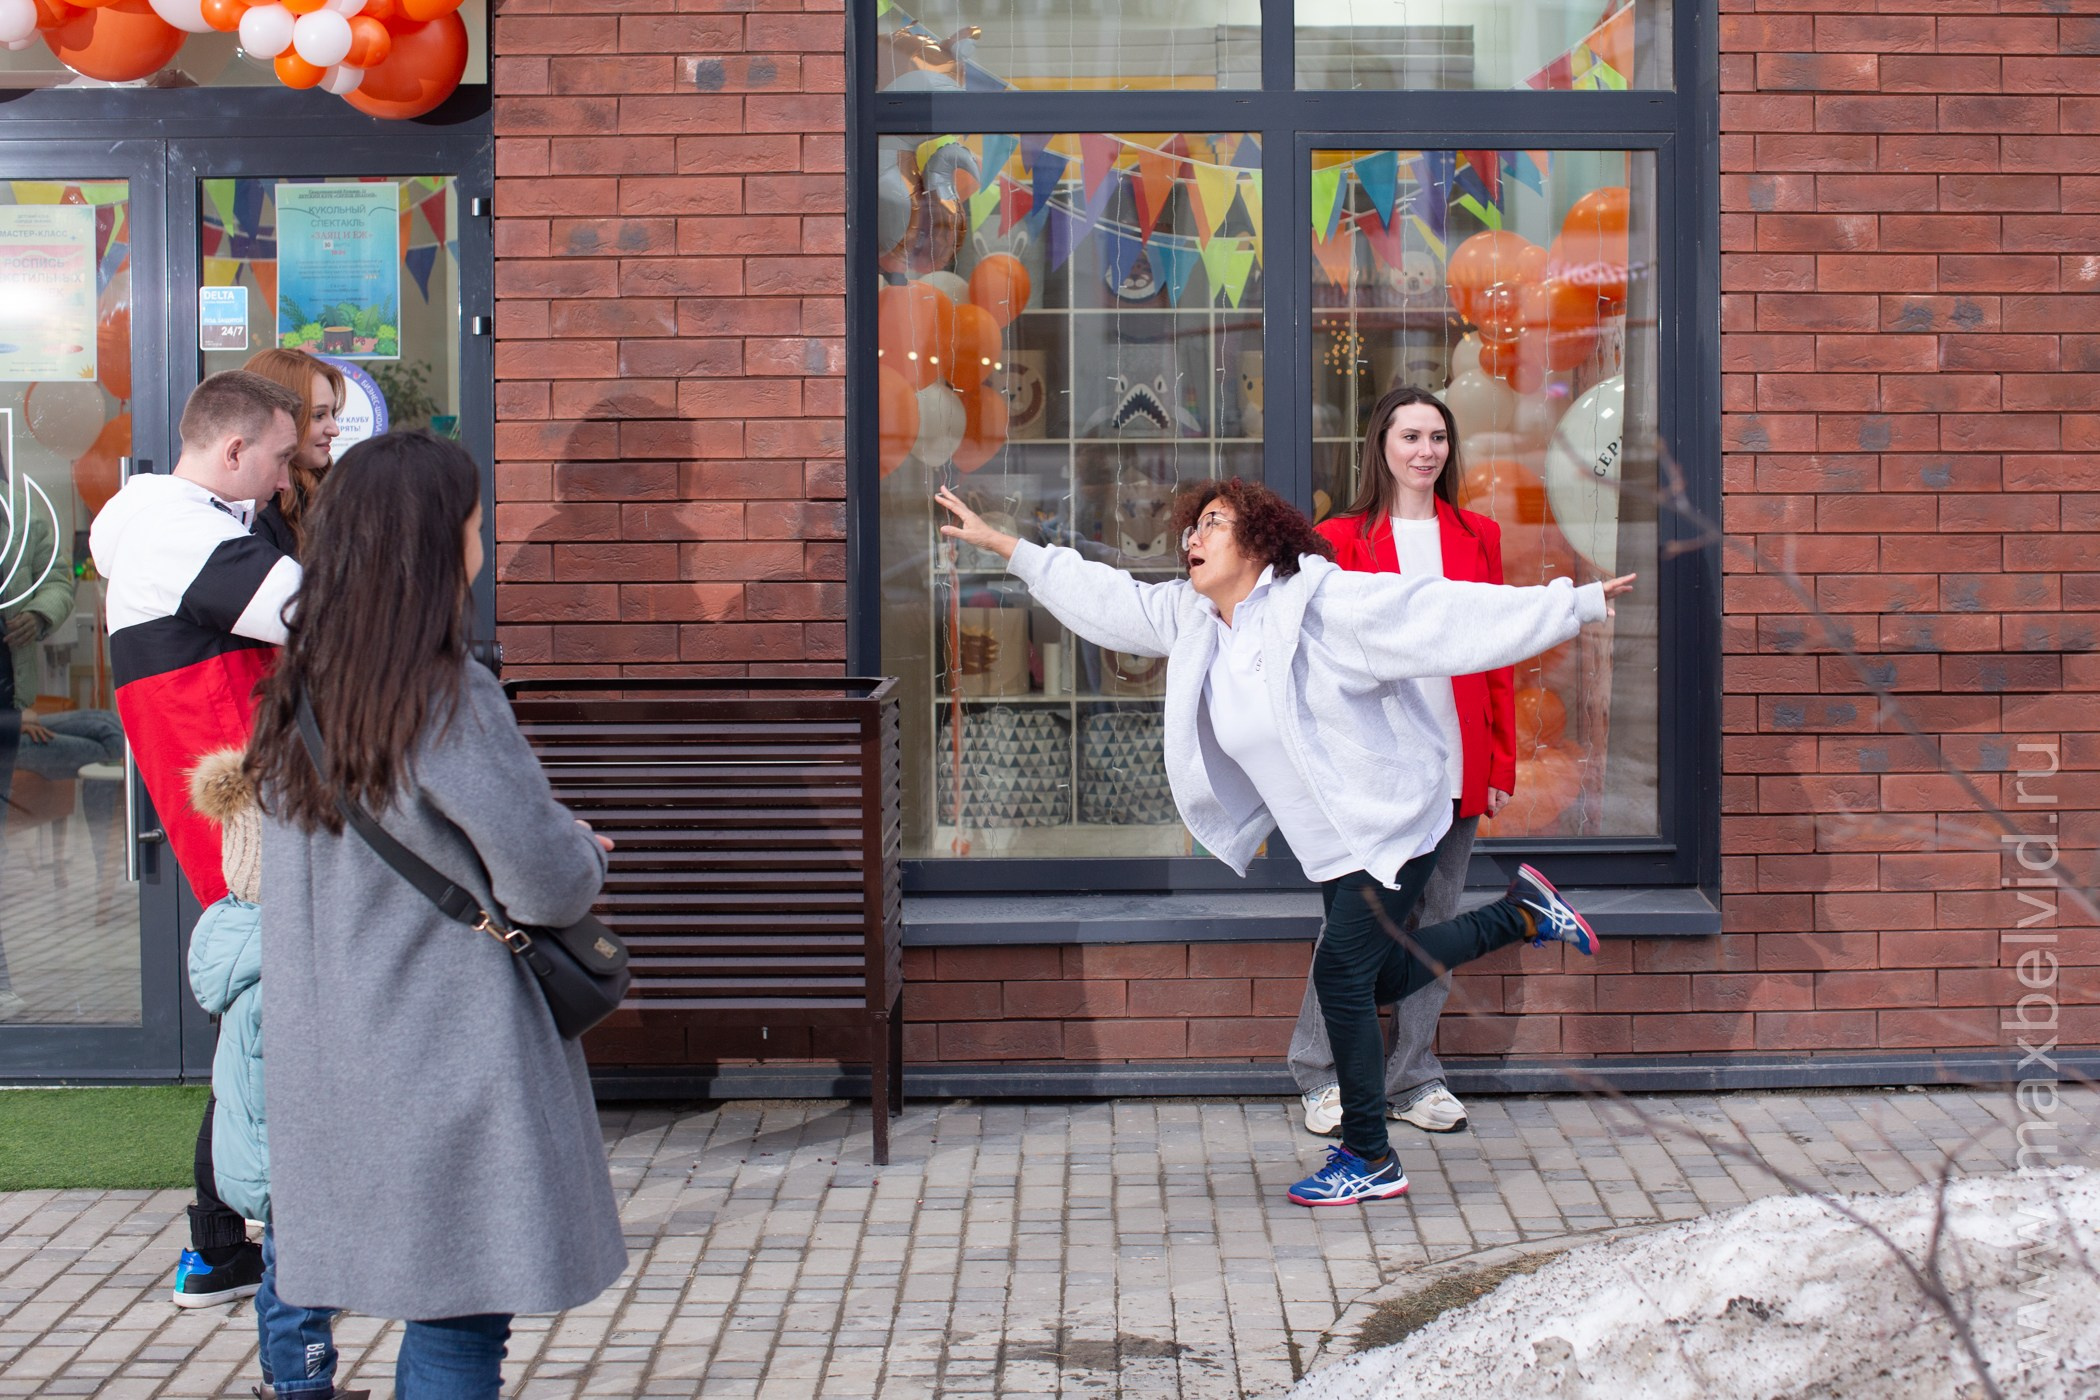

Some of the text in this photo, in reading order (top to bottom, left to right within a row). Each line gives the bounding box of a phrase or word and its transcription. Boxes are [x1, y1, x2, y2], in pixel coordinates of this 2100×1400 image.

[308, 204, 367, 215] КУКОЛЬНЫЙ
[310, 219, 365, 228] СПЕКТАКЛЬ
[203, 290, 235, 300] DELTA
[221, 326, 244, 337] 24/7
[1593, 435, 1623, 478] СЕР
